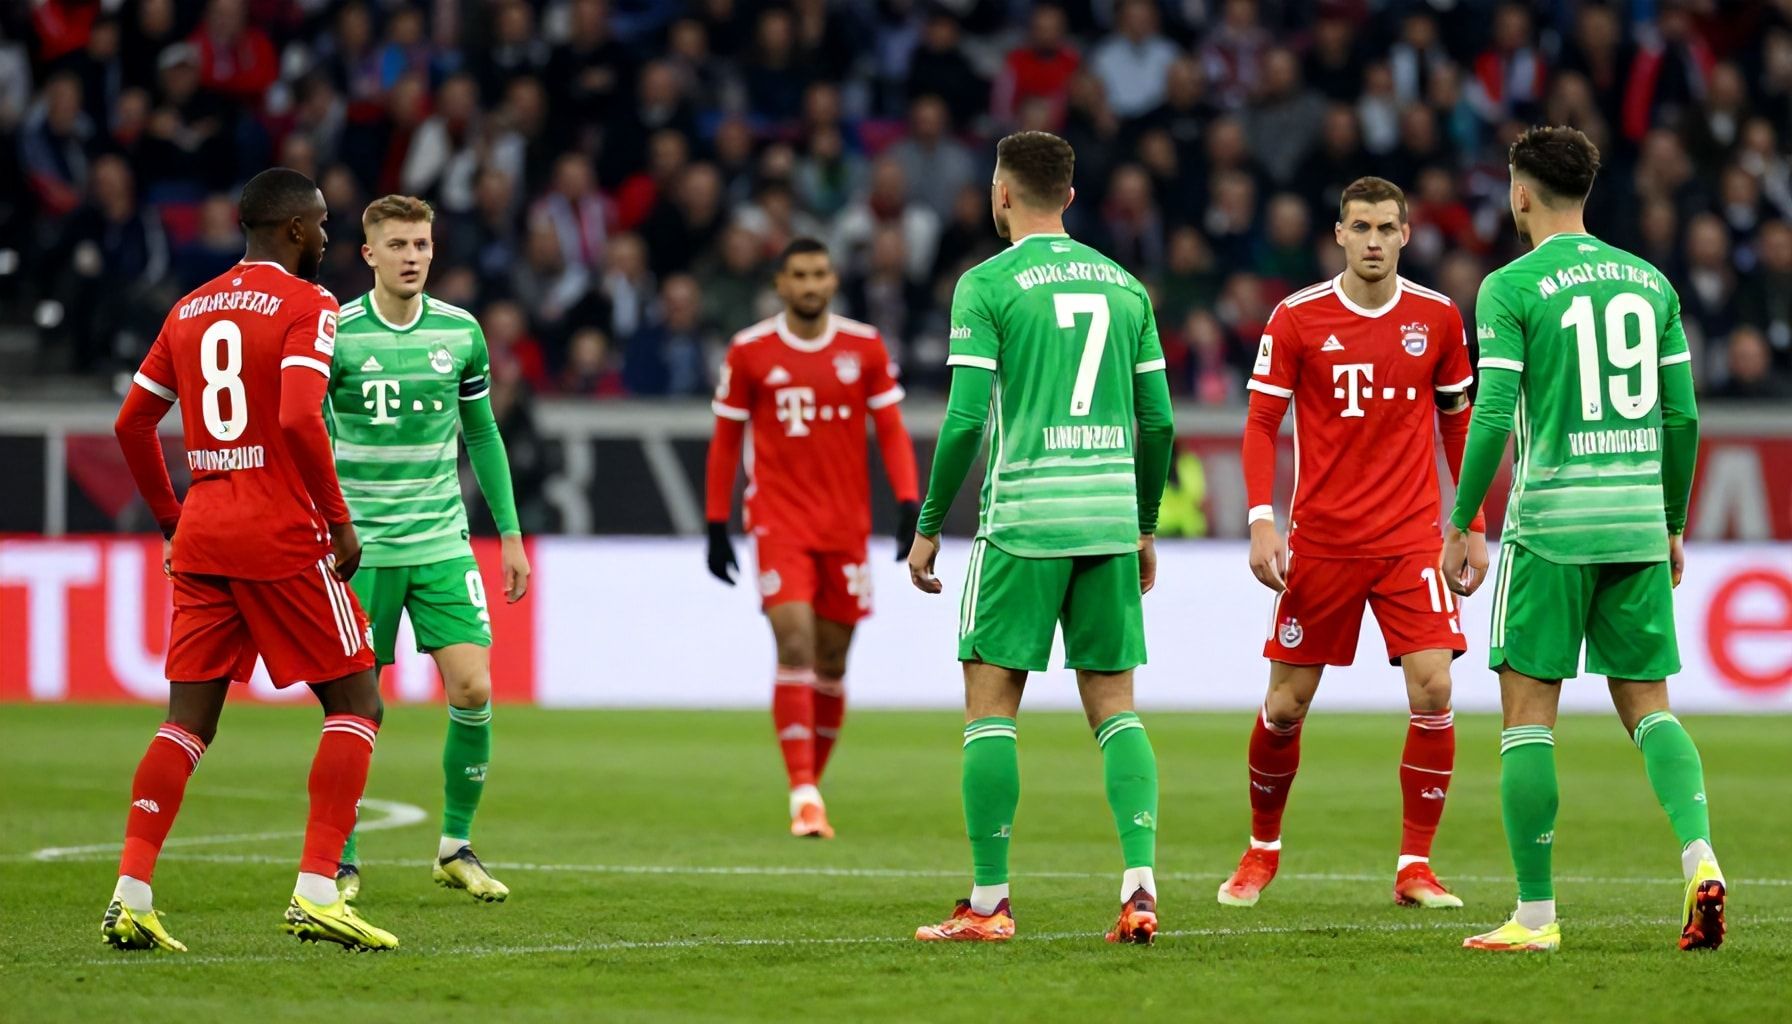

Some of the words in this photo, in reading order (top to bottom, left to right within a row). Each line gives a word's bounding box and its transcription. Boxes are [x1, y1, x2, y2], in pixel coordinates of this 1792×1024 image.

[200, 319, 248, 442] 8
[1053, 292, 1111, 417] 7
[1560, 292, 1659, 421] 19
